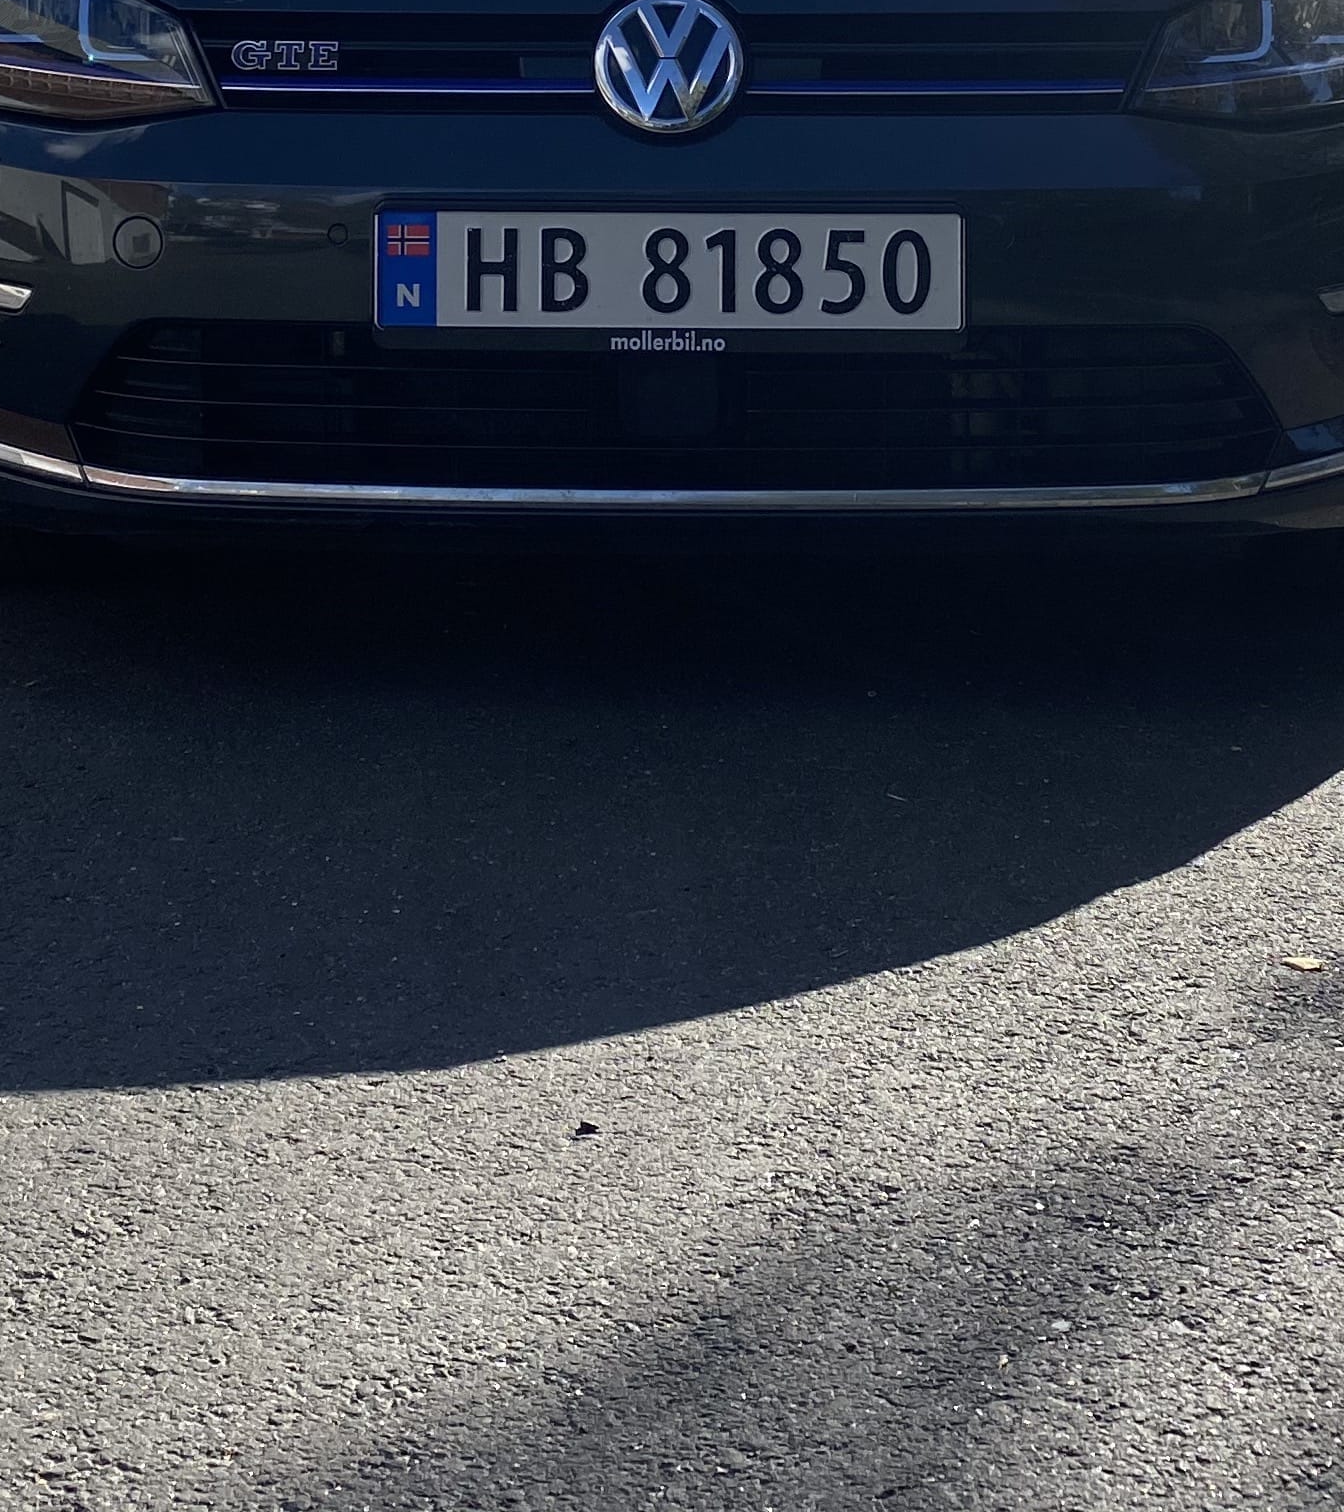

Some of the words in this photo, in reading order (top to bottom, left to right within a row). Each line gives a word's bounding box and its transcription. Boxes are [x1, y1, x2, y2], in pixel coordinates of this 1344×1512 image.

[230, 39, 339, 72] GTE
[464, 226, 588, 313] HB
[640, 227, 932, 315] 81850
[396, 283, 420, 308] N
[610, 330, 726, 351] mollerbil.no
